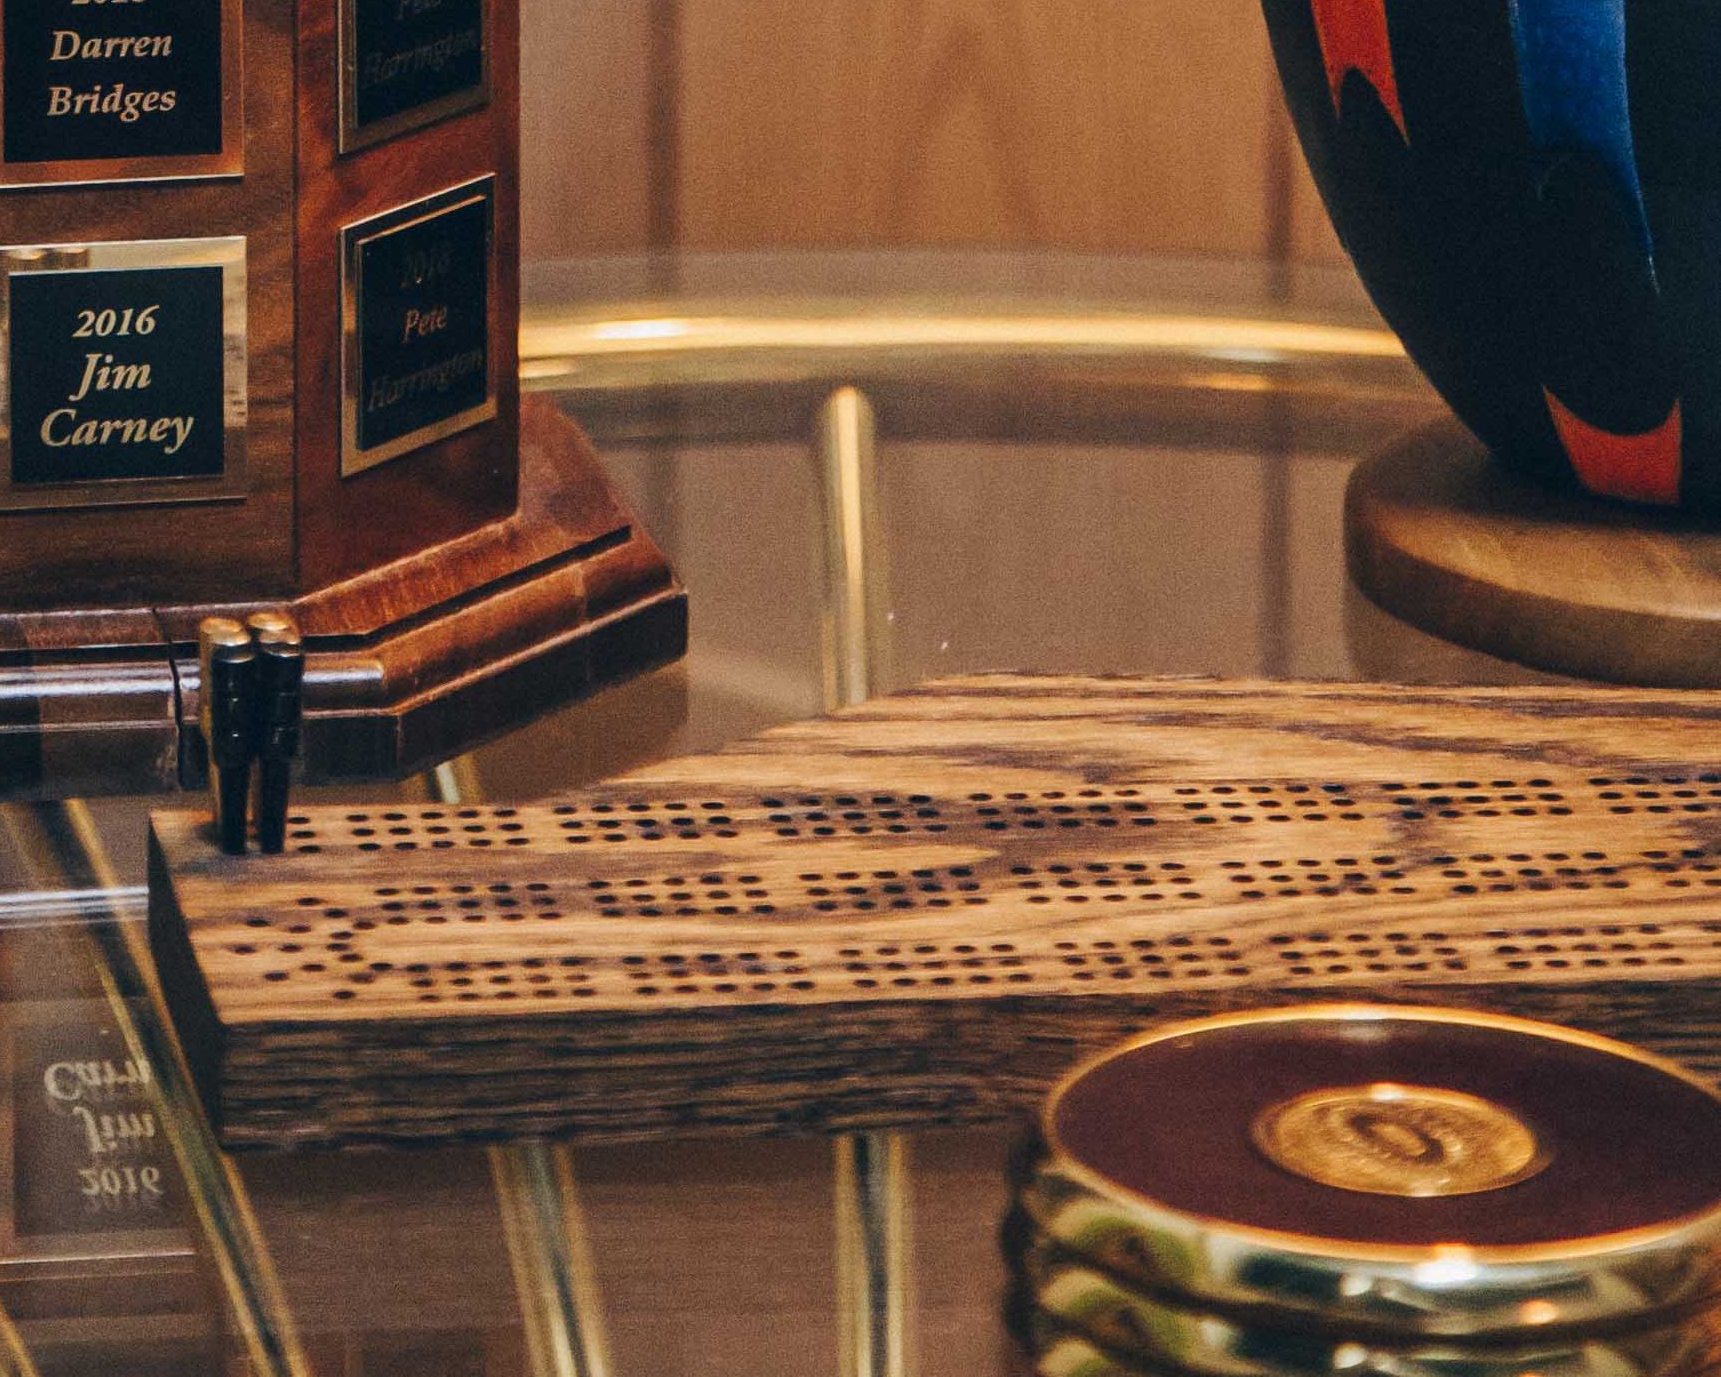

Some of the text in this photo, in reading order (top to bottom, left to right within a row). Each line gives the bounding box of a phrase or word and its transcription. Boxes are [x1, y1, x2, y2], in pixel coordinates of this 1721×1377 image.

[50, 30, 174, 62] Darren
[46, 82, 177, 122] Bridges
[72, 304, 160, 339] 2016
[401, 303, 448, 345] Pete
[68, 352, 152, 402] Jim
[39, 406, 195, 454] Carney
